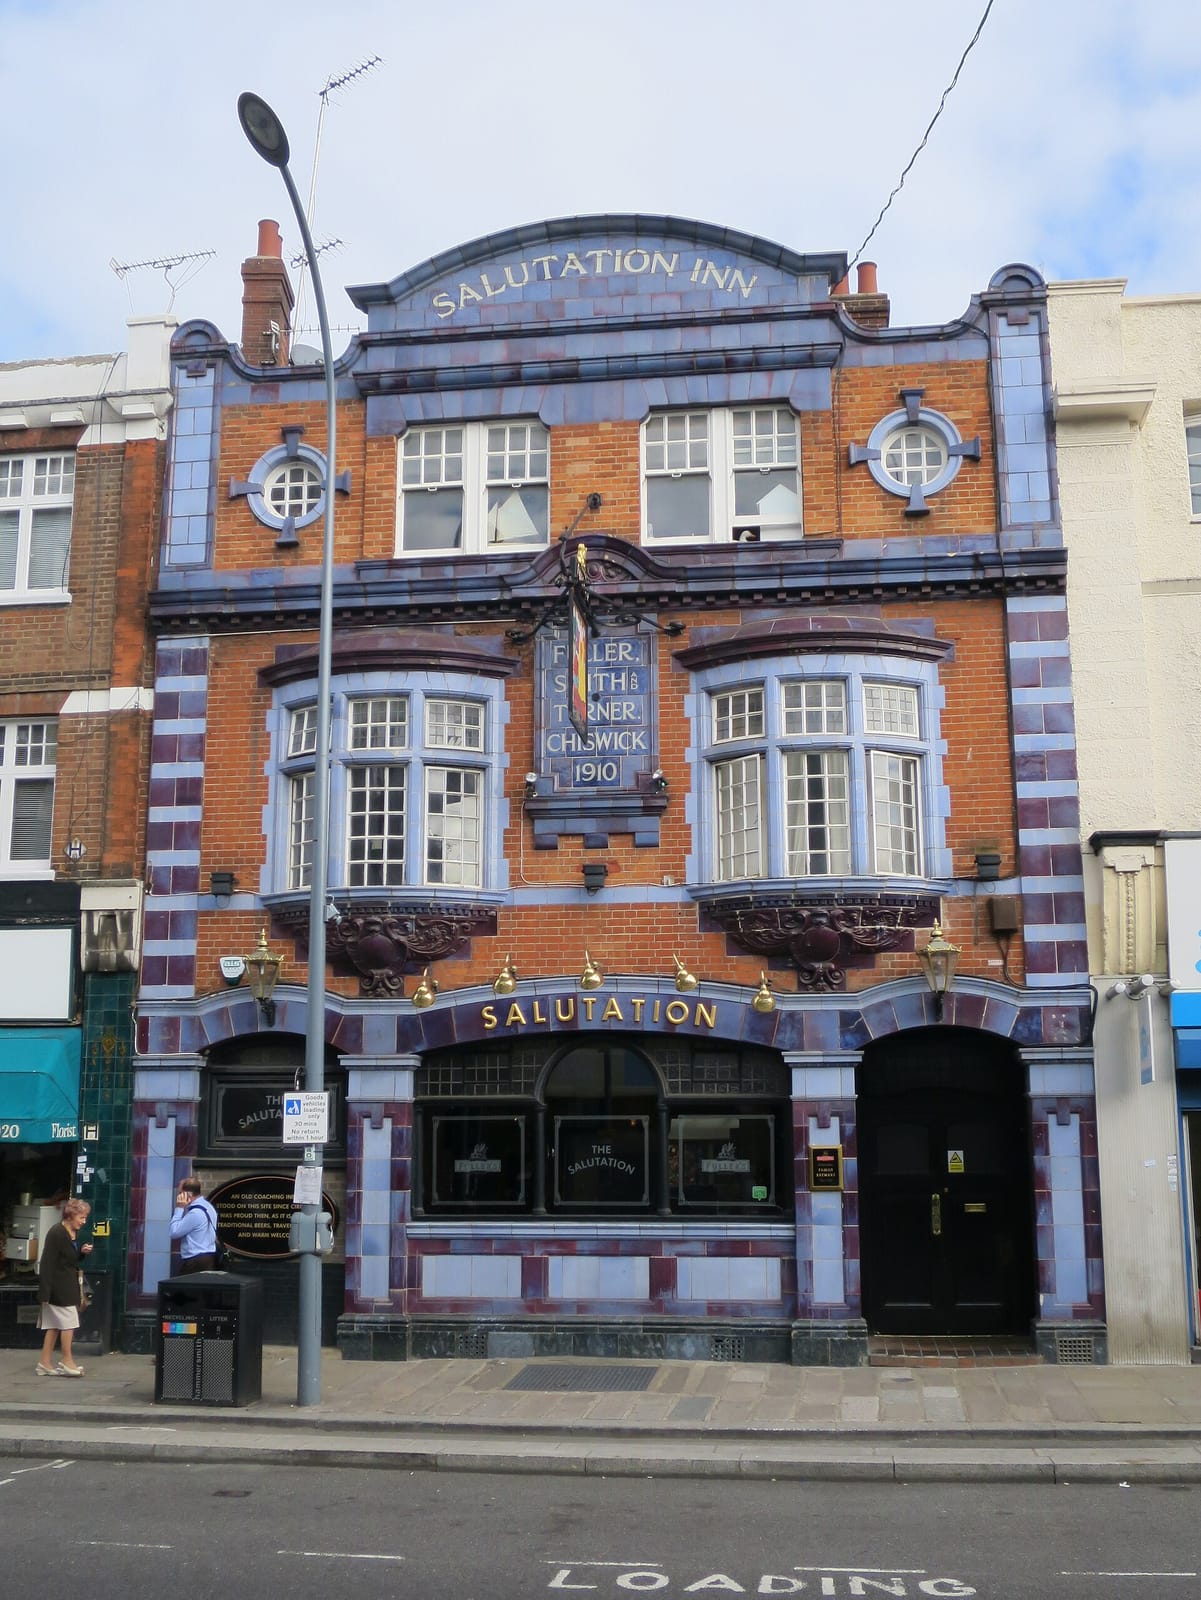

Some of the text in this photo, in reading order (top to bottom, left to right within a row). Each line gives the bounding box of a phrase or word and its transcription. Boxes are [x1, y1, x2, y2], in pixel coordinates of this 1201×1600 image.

[432, 249, 758, 319] SALUTATION INN
[553, 642, 640, 664] FLER,
[554, 672, 626, 693] SITH
[553, 701, 641, 722] TRNER.
[546, 730, 648, 752] CHISWICK
[575, 763, 617, 782] 1910
[69, 842, 82, 856] H
[481, 997, 718, 1030] SALUTATION
[265, 1095, 284, 1105] TH
[0, 1124, 20, 1138] 20
[51, 1122, 77, 1138] Florist
[86, 1124, 98, 1138] H
[592, 1145, 611, 1154] THE
[567, 1157, 636, 1175] SALUTATION
[547, 1569, 977, 1597] LOADING
